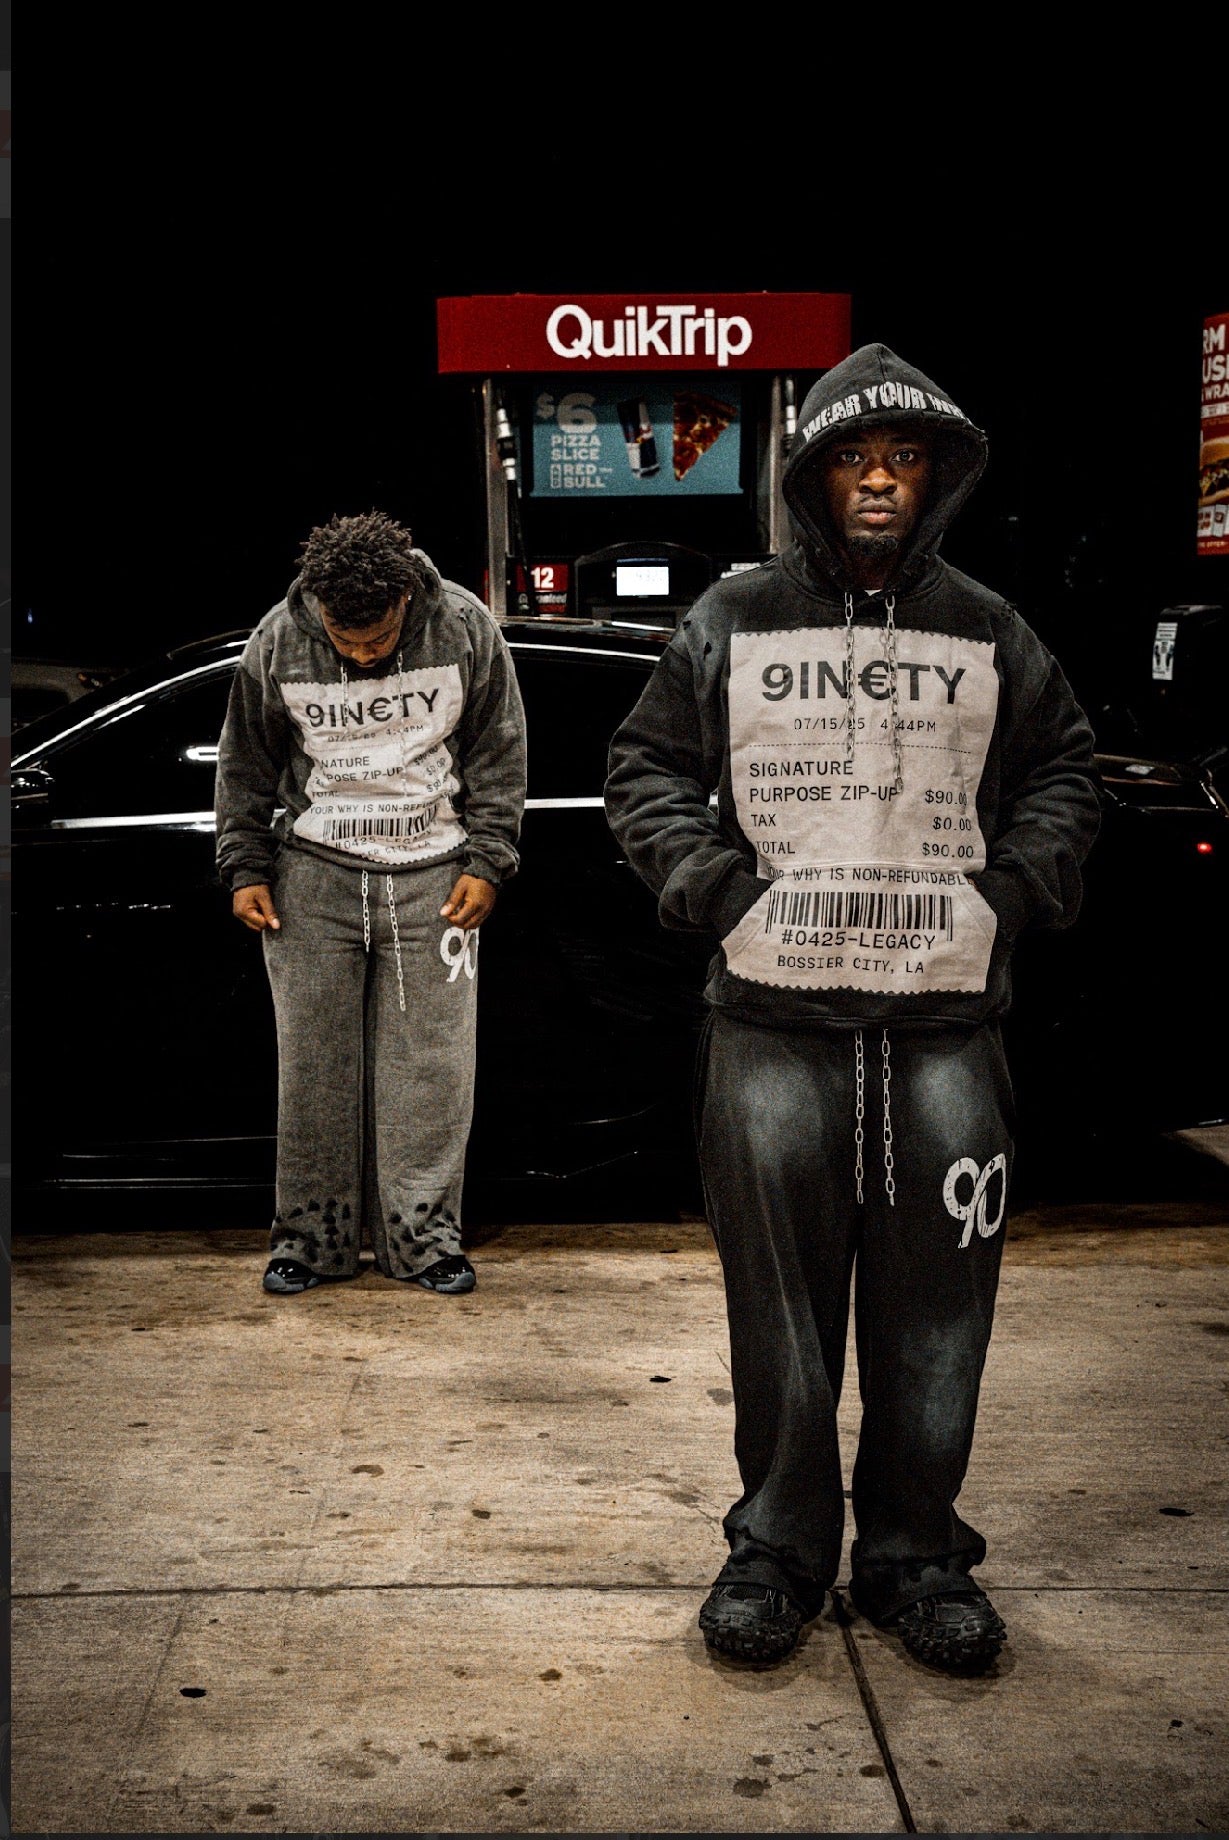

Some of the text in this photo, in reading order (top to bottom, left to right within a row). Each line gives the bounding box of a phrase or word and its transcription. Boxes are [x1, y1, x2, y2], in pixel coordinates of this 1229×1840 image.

[546, 304, 753, 367] QuikTrip
[537, 393, 598, 433] $6
[802, 394, 862, 442] WEAR
[863, 381, 927, 410] YOUR
[551, 435, 600, 447] PIZZA
[551, 448, 599, 460] SLICE
[563, 464, 597, 475] RED
[563, 476, 605, 488] BULL
[531, 567, 554, 589] 12
[880, 716, 936, 732] 444PM
[362, 767, 404, 780] ZIP-UP
[750, 761, 853, 777] SIGNATURE
[750, 785, 968, 806] PURPOSE ZIP-UP $90.00
[337, 804, 358, 813] WHY
[362, 803, 374, 812] IS
[751, 814, 972, 831] TAX $0.00
[757, 841, 974, 858] TOTAL $90.00
[793, 868, 822, 881] WHY
[830, 867, 844, 880] IS
[852, 868, 966, 886] NON-REFUNDABL
[782, 930, 936, 950] #0425-LEGACY
[440, 926, 480, 983] 90
[777, 955, 924, 974] BOSSIER CITY, LA
[942, 1153, 1007, 1249] 90
